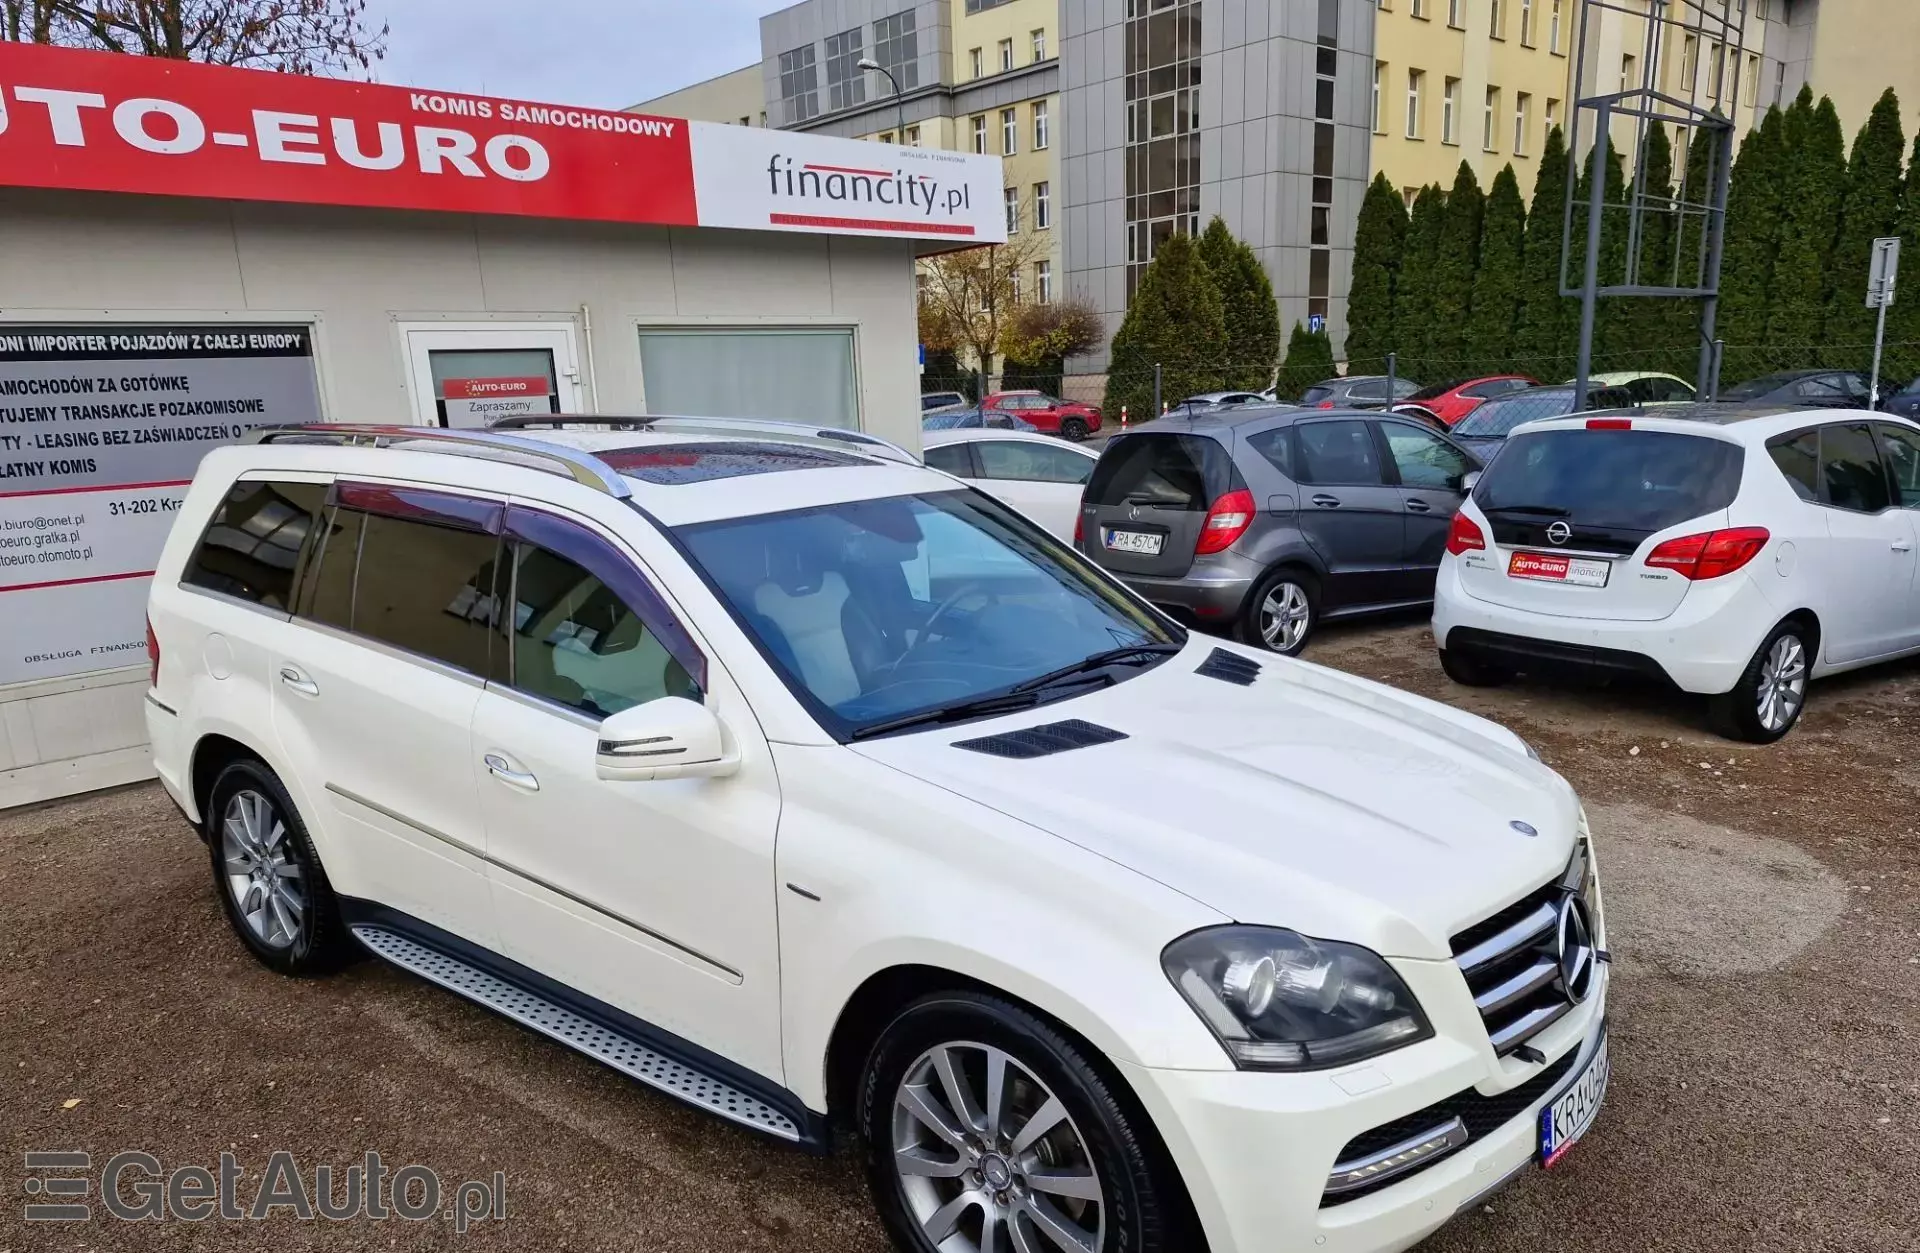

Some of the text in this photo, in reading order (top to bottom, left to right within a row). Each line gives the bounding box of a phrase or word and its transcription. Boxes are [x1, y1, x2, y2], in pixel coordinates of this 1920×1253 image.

[410, 93, 675, 138] KOMIS SAMOCHODOWY
[0, 84, 550, 182] TO-EURO
[767, 153, 970, 215] financity.pl
[28, 335, 108, 352] IMPORTER
[110, 331, 188, 351] POJAZDÓW
[192, 334, 201, 350] Z
[204, 333, 247, 350] CAŁEJ
[250, 332, 302, 349] EUROPY
[97, 378, 118, 393] ZA
[120, 374, 190, 394] GOTÓWKĘ
[471, 382, 527, 392] AUTO-EURO
[61, 403, 156, 421] TRANSAKCJE
[159, 399, 265, 417] POZAKOMISOWE
[35, 431, 99, 449] LEASING
[102, 430, 132, 446] BEZ
[133, 422, 229, 444] ZAŚWIADCZEŃ
[232, 424, 242, 439] O
[49, 458, 97, 475] KOMIS
[109, 499, 158, 516] 31-202
[0, 514, 85, 531] .biuro@onet.pl
[0, 530, 81, 549] oeuro.gratka.pl
[1113, 532, 1161, 550] KRA 457CM
[0, 546, 93, 567] toeuro.otomoto.pl
[1515, 559, 1566, 573] AUTO-EURO
[24, 649, 83, 664] OBSŁUGA
[1553, 1084, 1585, 1146] KRA
